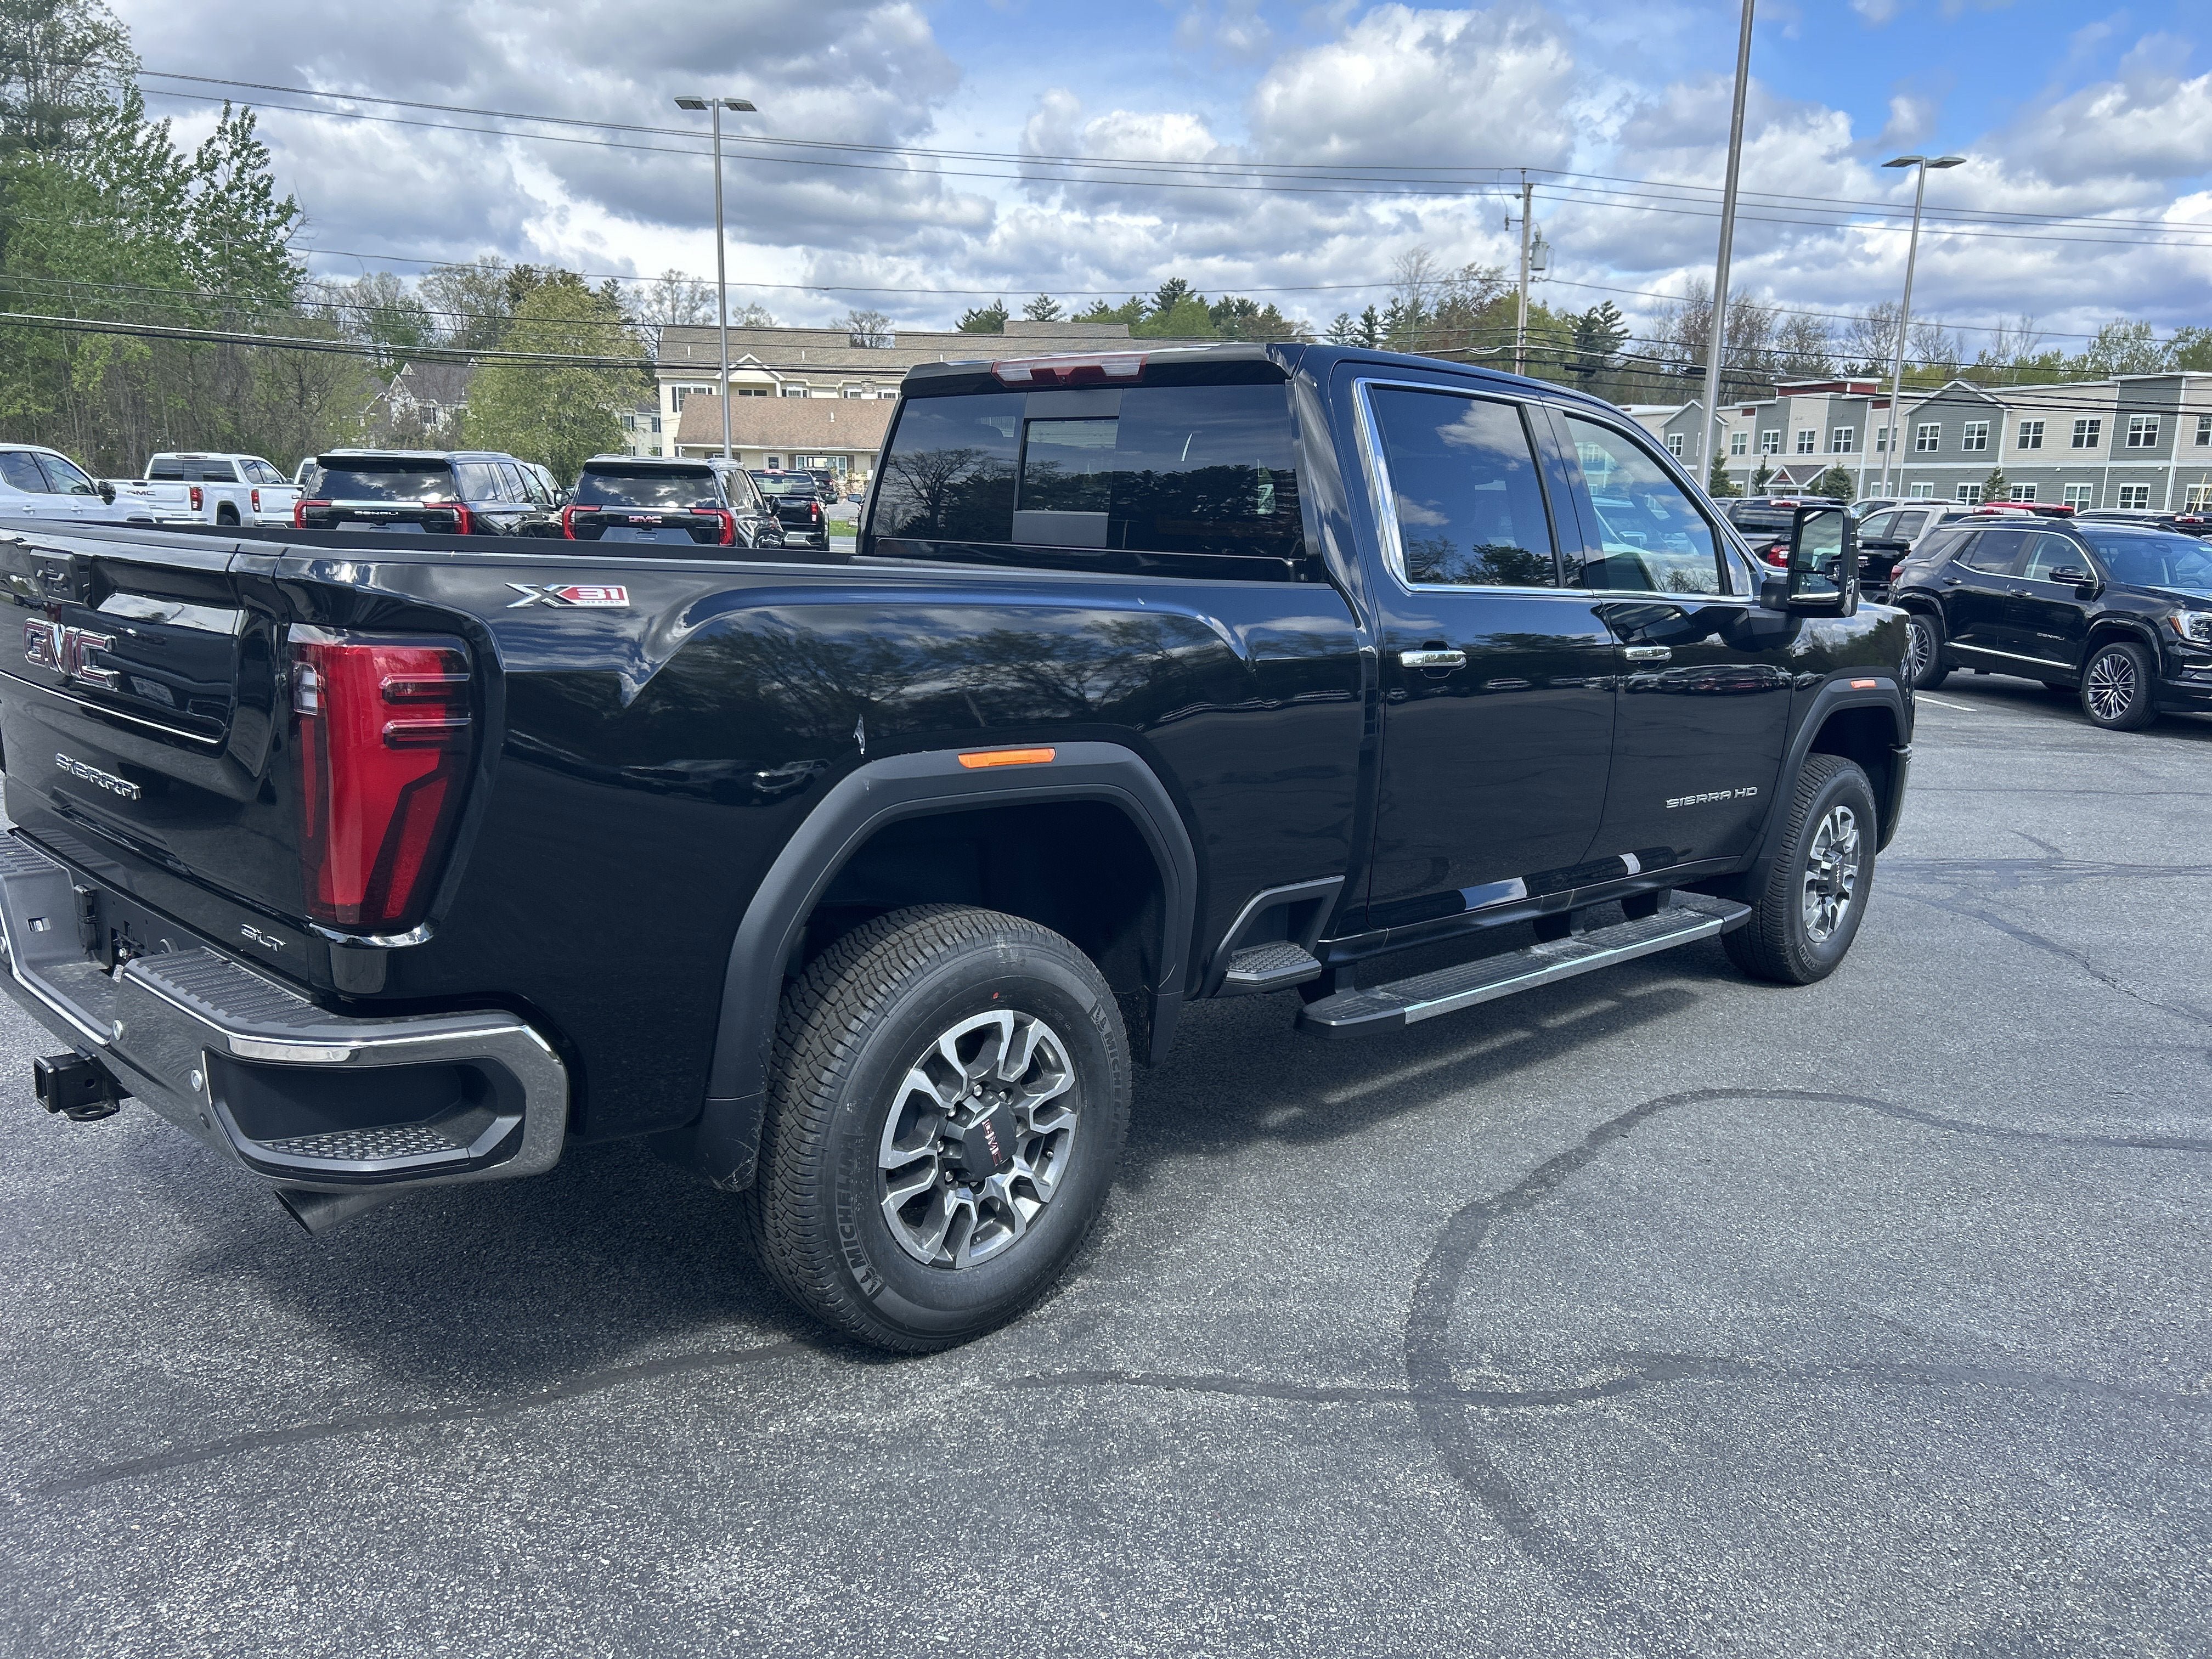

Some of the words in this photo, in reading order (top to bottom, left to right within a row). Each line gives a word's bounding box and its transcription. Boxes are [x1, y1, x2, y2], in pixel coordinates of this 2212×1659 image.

[628, 515, 663, 524] GMC
[505, 583, 630, 608] X31
[23, 617, 120, 691] GMC
[55, 752, 141, 800] SIERRA
[1665, 790, 1731, 809] SIERRA
[1734, 787, 1758, 799] HD
[241, 923, 287, 952] SLT
[981, 1118, 1003, 1166] GMC
[836, 1148, 868, 1269] MICHELIN
